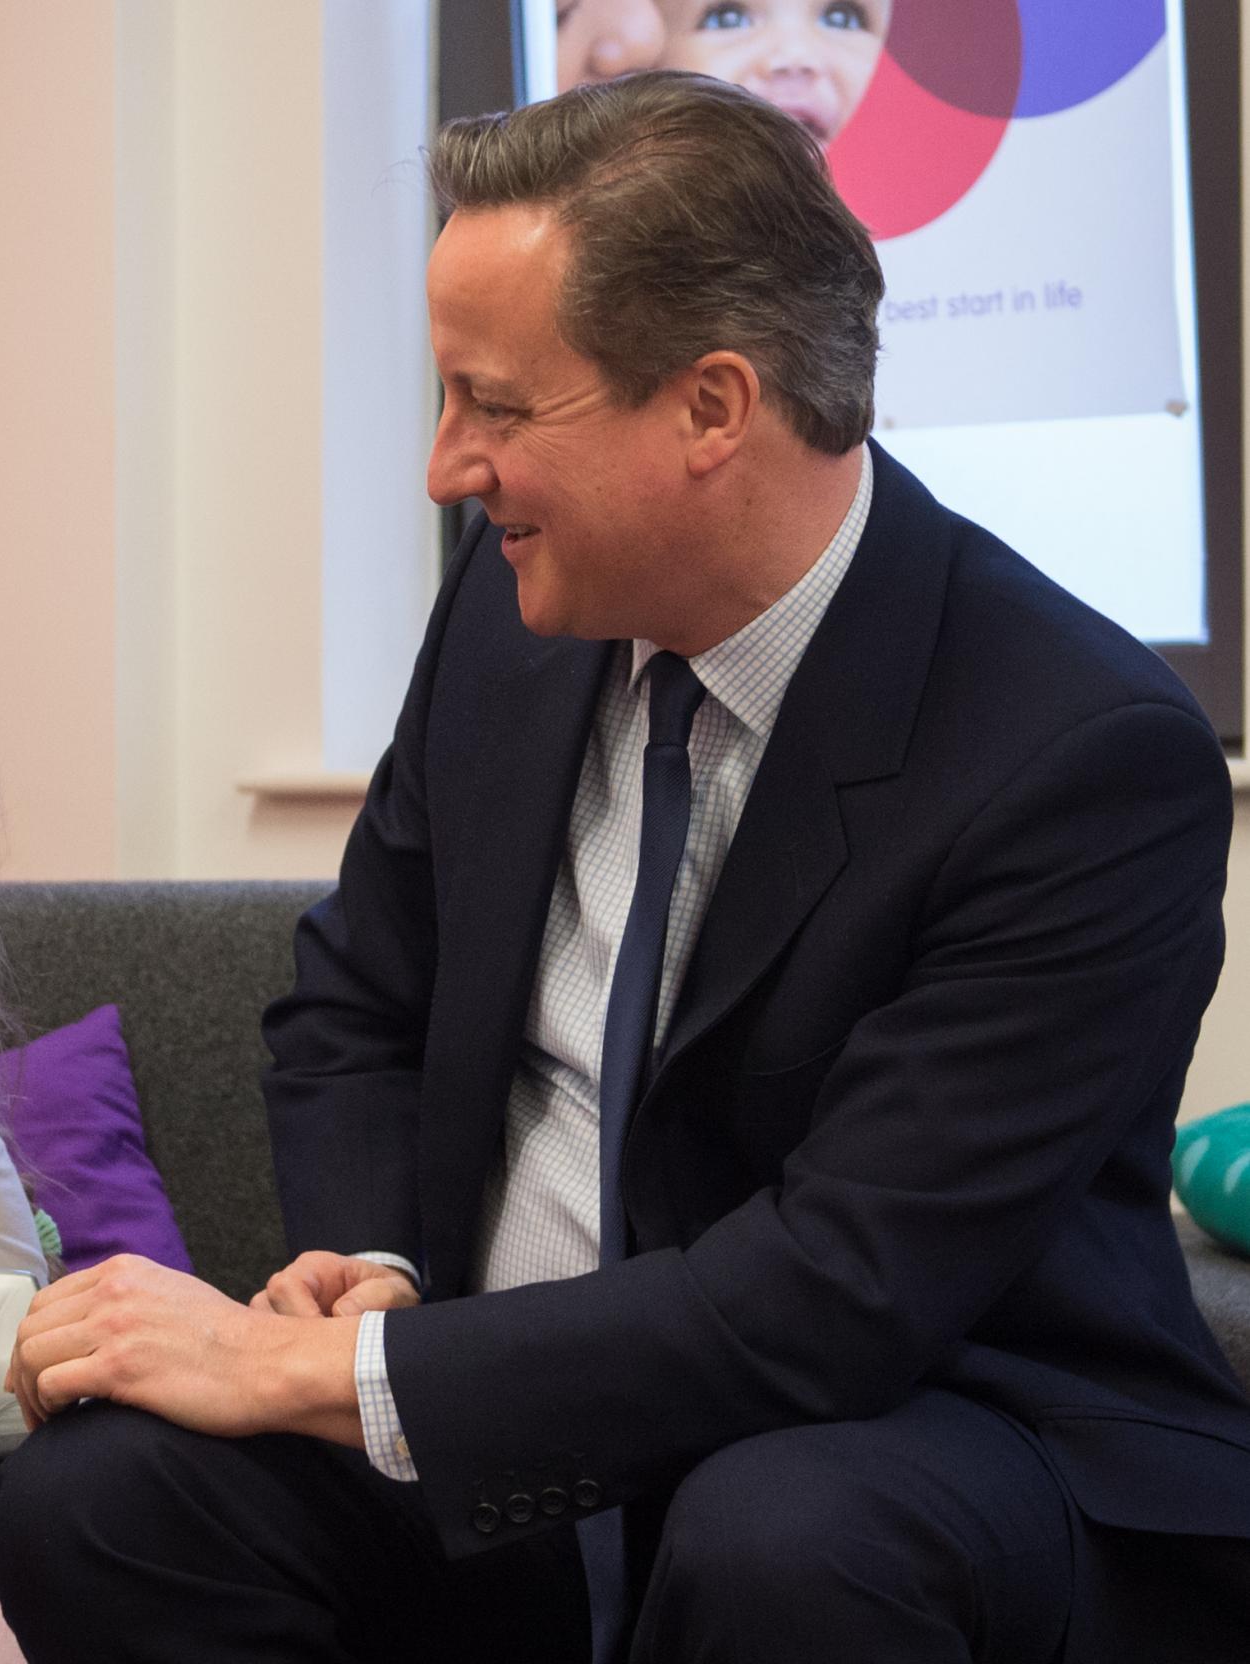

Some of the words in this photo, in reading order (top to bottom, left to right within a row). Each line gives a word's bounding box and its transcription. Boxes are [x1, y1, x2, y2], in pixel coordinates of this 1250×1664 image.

[884, 296, 938, 321] best
[947, 290, 1003, 318] start
[1013, 286, 1036, 313] in
[1044, 279, 1083, 309] life
